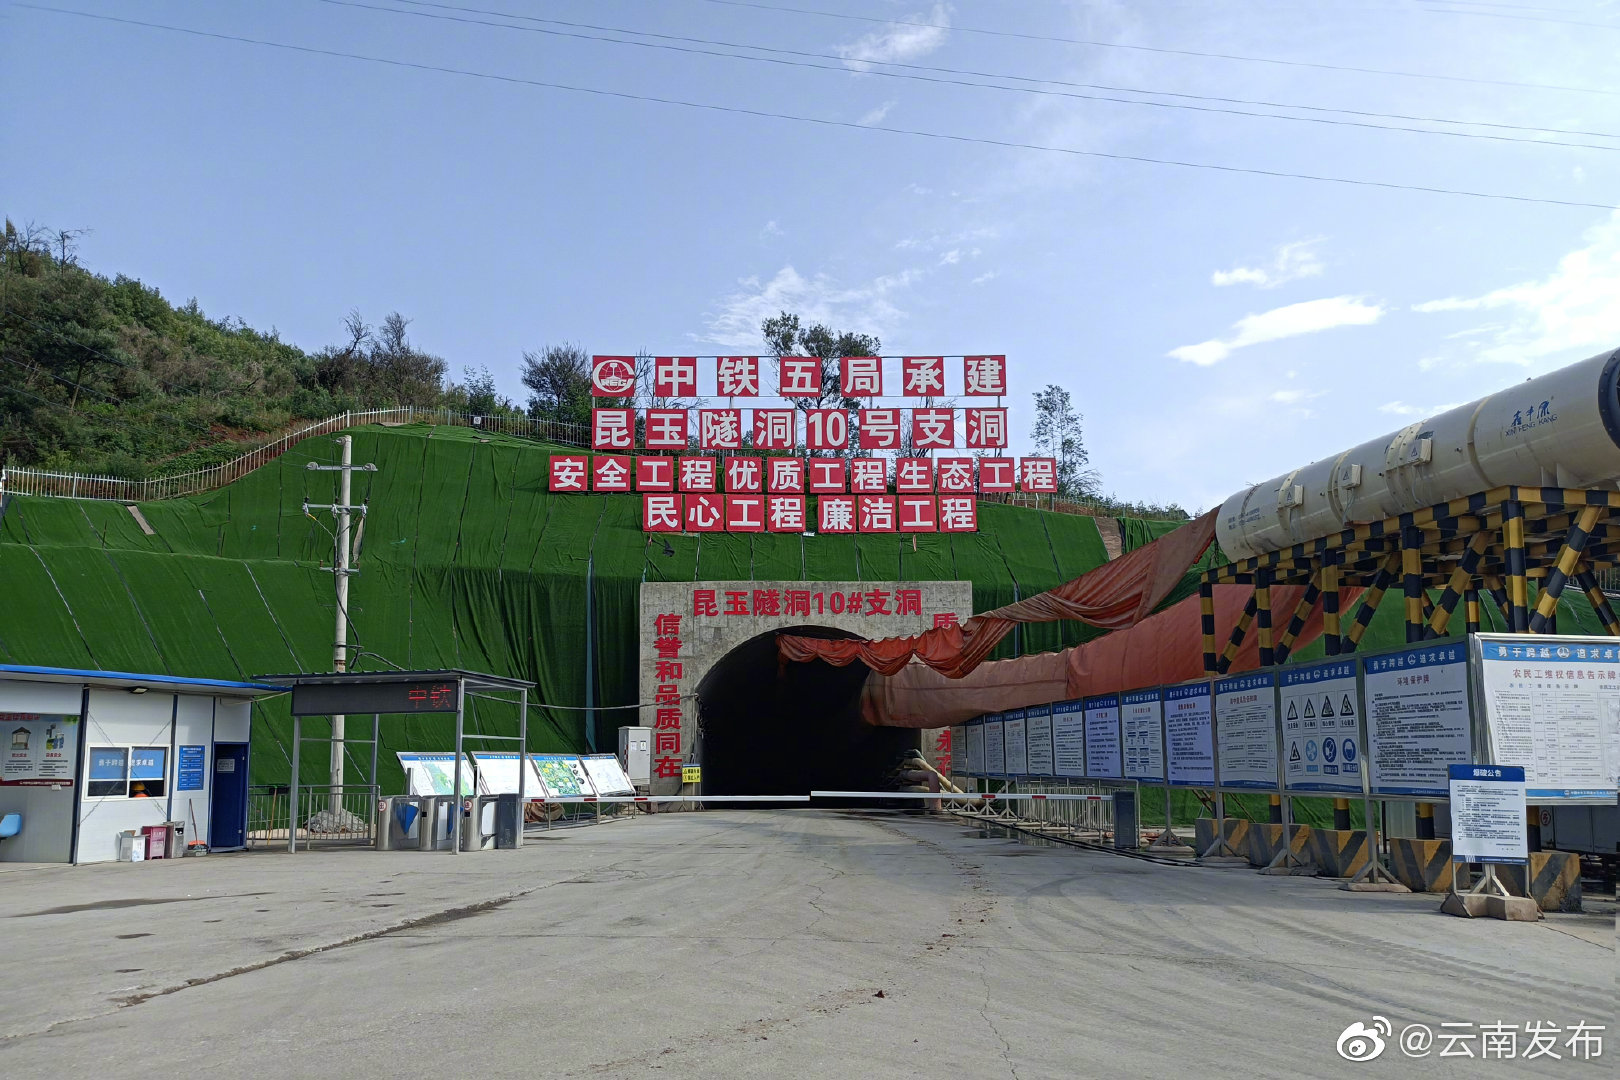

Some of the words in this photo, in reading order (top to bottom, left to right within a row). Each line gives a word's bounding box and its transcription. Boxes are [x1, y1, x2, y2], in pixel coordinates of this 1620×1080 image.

[659, 357, 1005, 397] 中铁五局承建
[595, 408, 1005, 448] 昆玉隧洞10号支洞
[553, 458, 1055, 491] 安全工程优质工程生态工程
[647, 495, 976, 531] 民心工程廉洁工程
[693, 589, 922, 617] 昆玉隧洞10#支洞
[1498, 646, 1551, 658] 勇于跨越
[408, 684, 451, 709] 中铁
[653, 613, 683, 778] 信誉和品质同在
